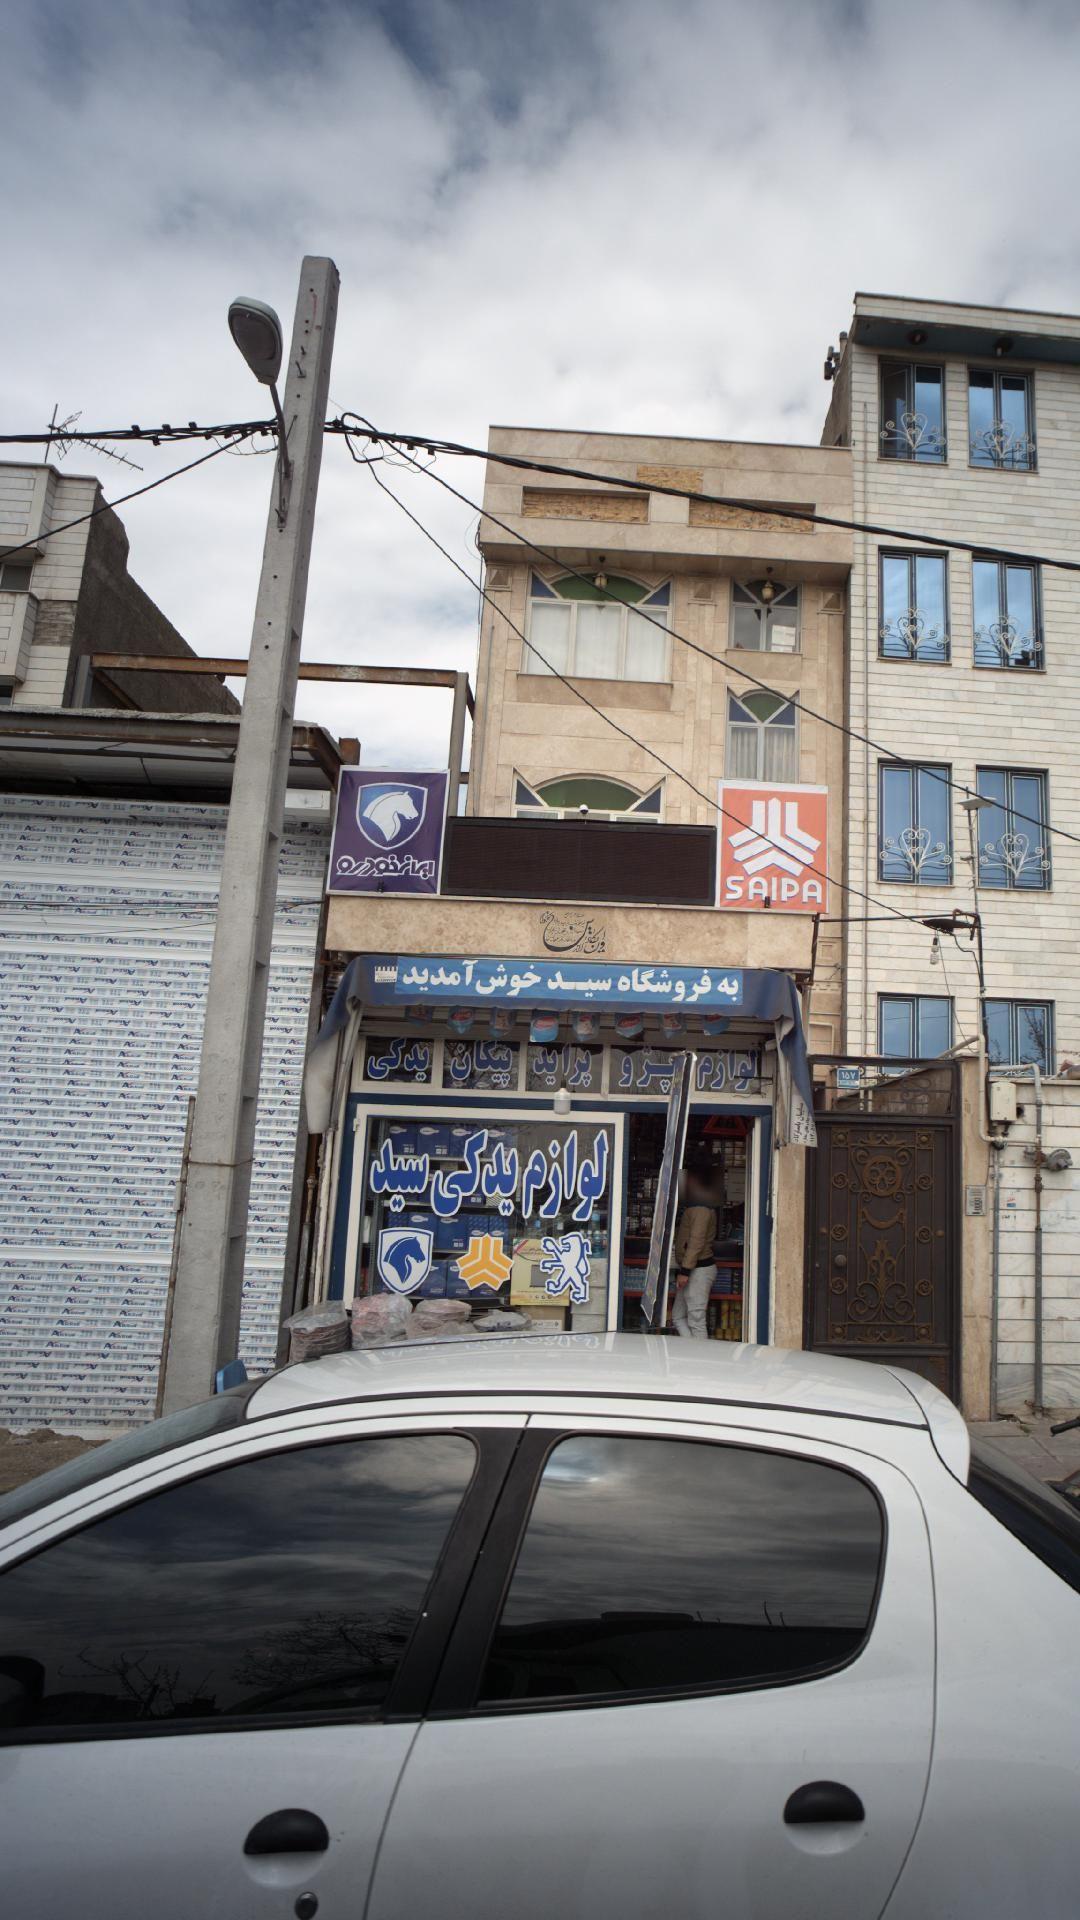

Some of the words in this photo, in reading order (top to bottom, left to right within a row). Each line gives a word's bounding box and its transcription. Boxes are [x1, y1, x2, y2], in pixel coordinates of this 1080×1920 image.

[725, 875, 823, 904] SAIPA
[402, 959, 479, 991] آمدید
[475, 963, 542, 996] خوش
[547, 970, 612, 997] سید
[617, 968, 712, 1002] فروشگاه
[717, 975, 740, 1001] به
[366, 1038, 430, 1082] یدکی
[450, 1039, 513, 1088] پیکان
[533, 1042, 592, 1087] پراید
[697, 1049, 758, 1091] لوازم
[841, 1071, 856, 1080] ۱۵۷
[369, 1138, 430, 1212] سید
[430, 1128, 519, 1217] یدکی
[522, 1129, 609, 1222] لوازم
